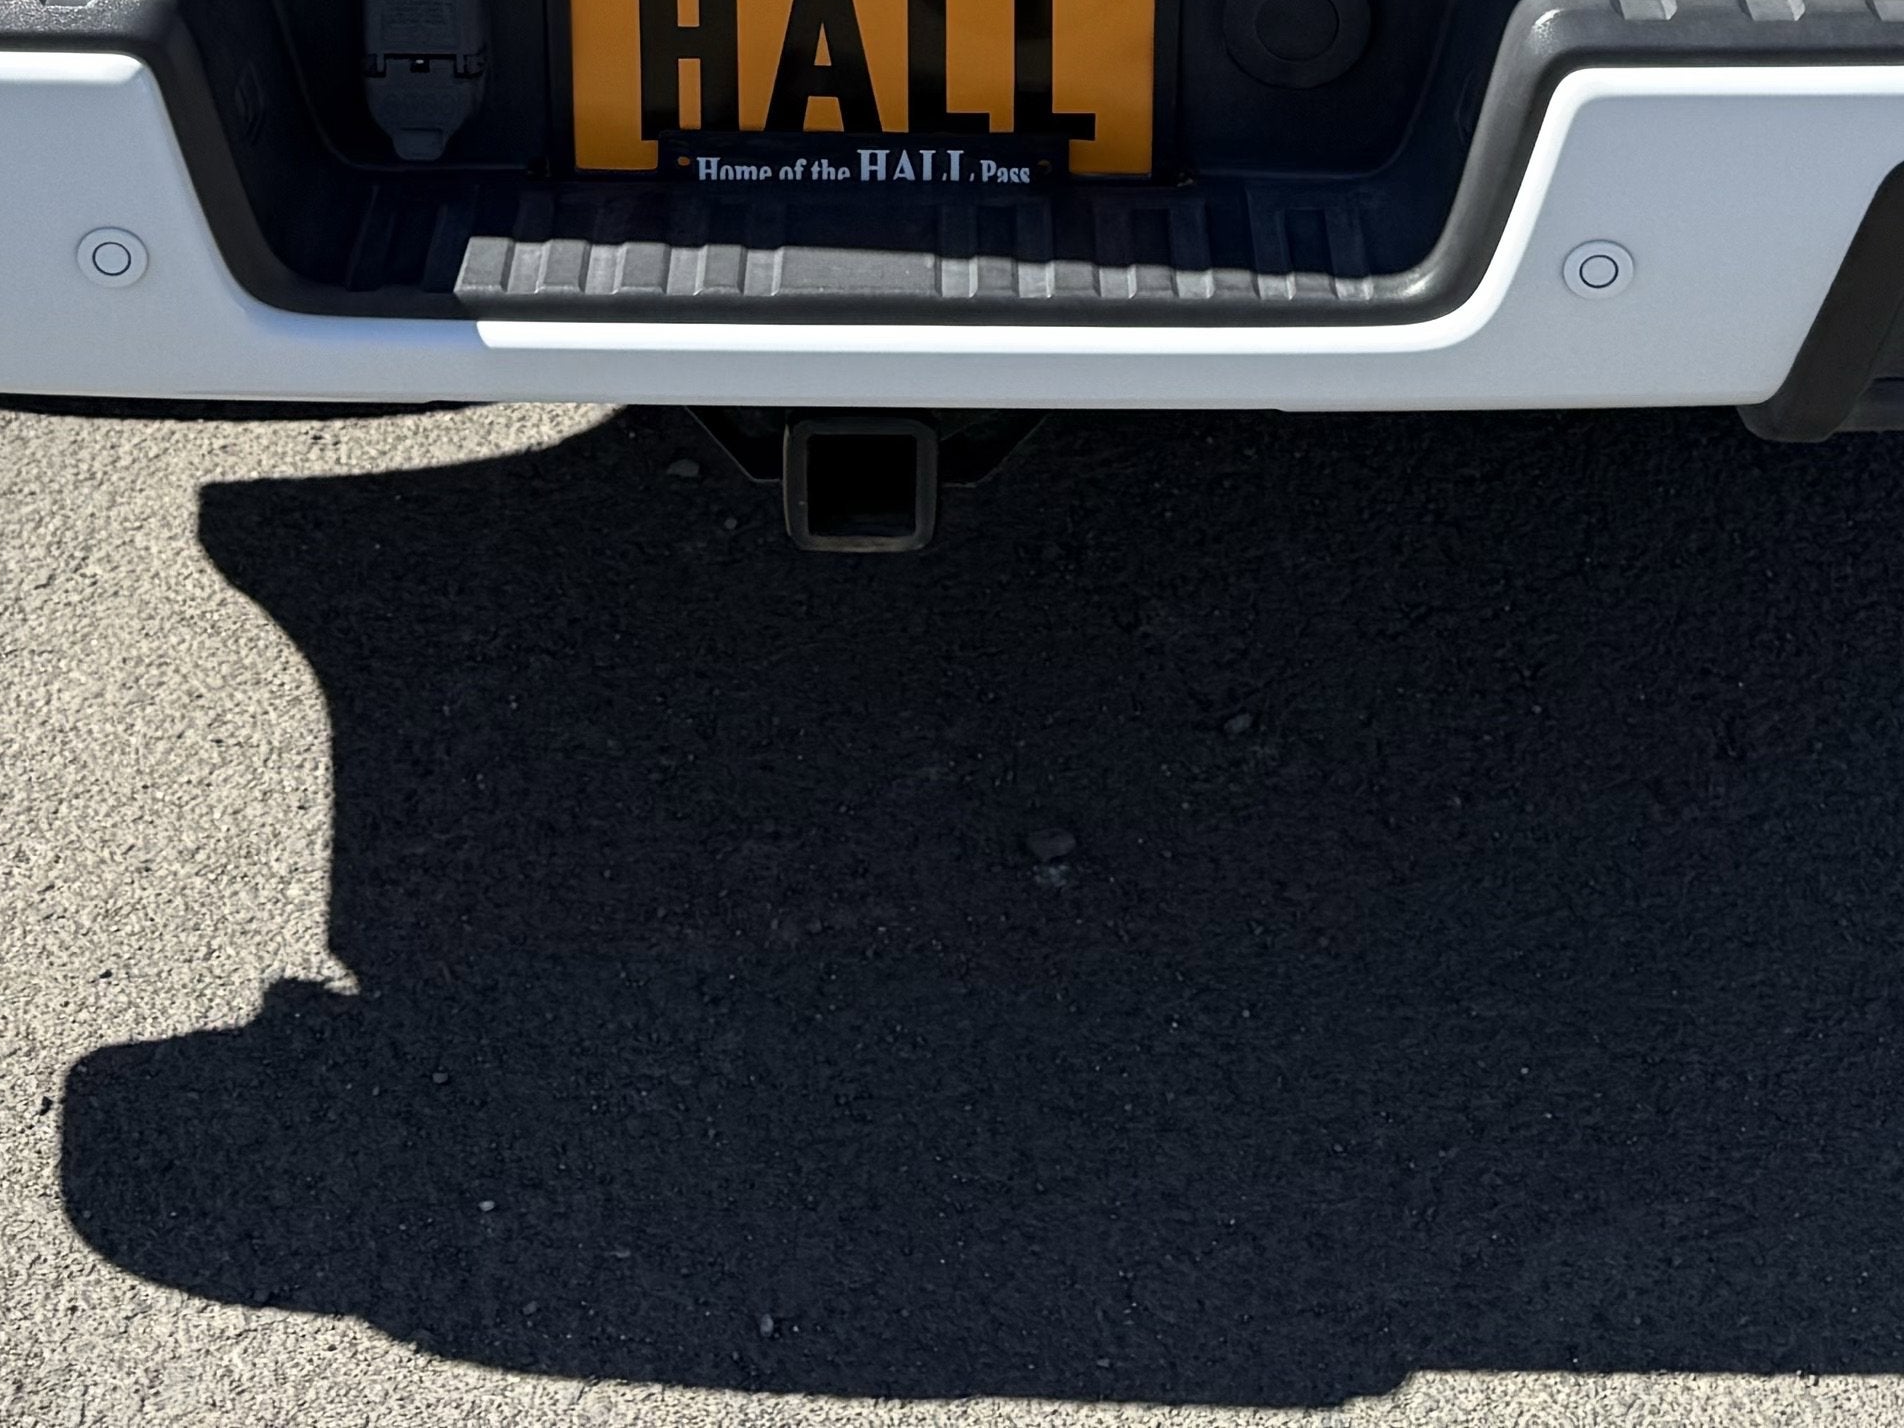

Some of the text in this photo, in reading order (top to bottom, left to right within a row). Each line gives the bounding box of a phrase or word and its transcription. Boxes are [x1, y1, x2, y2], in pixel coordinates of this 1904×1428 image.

[697, 148, 1031, 184] Home of the HALL Pass
